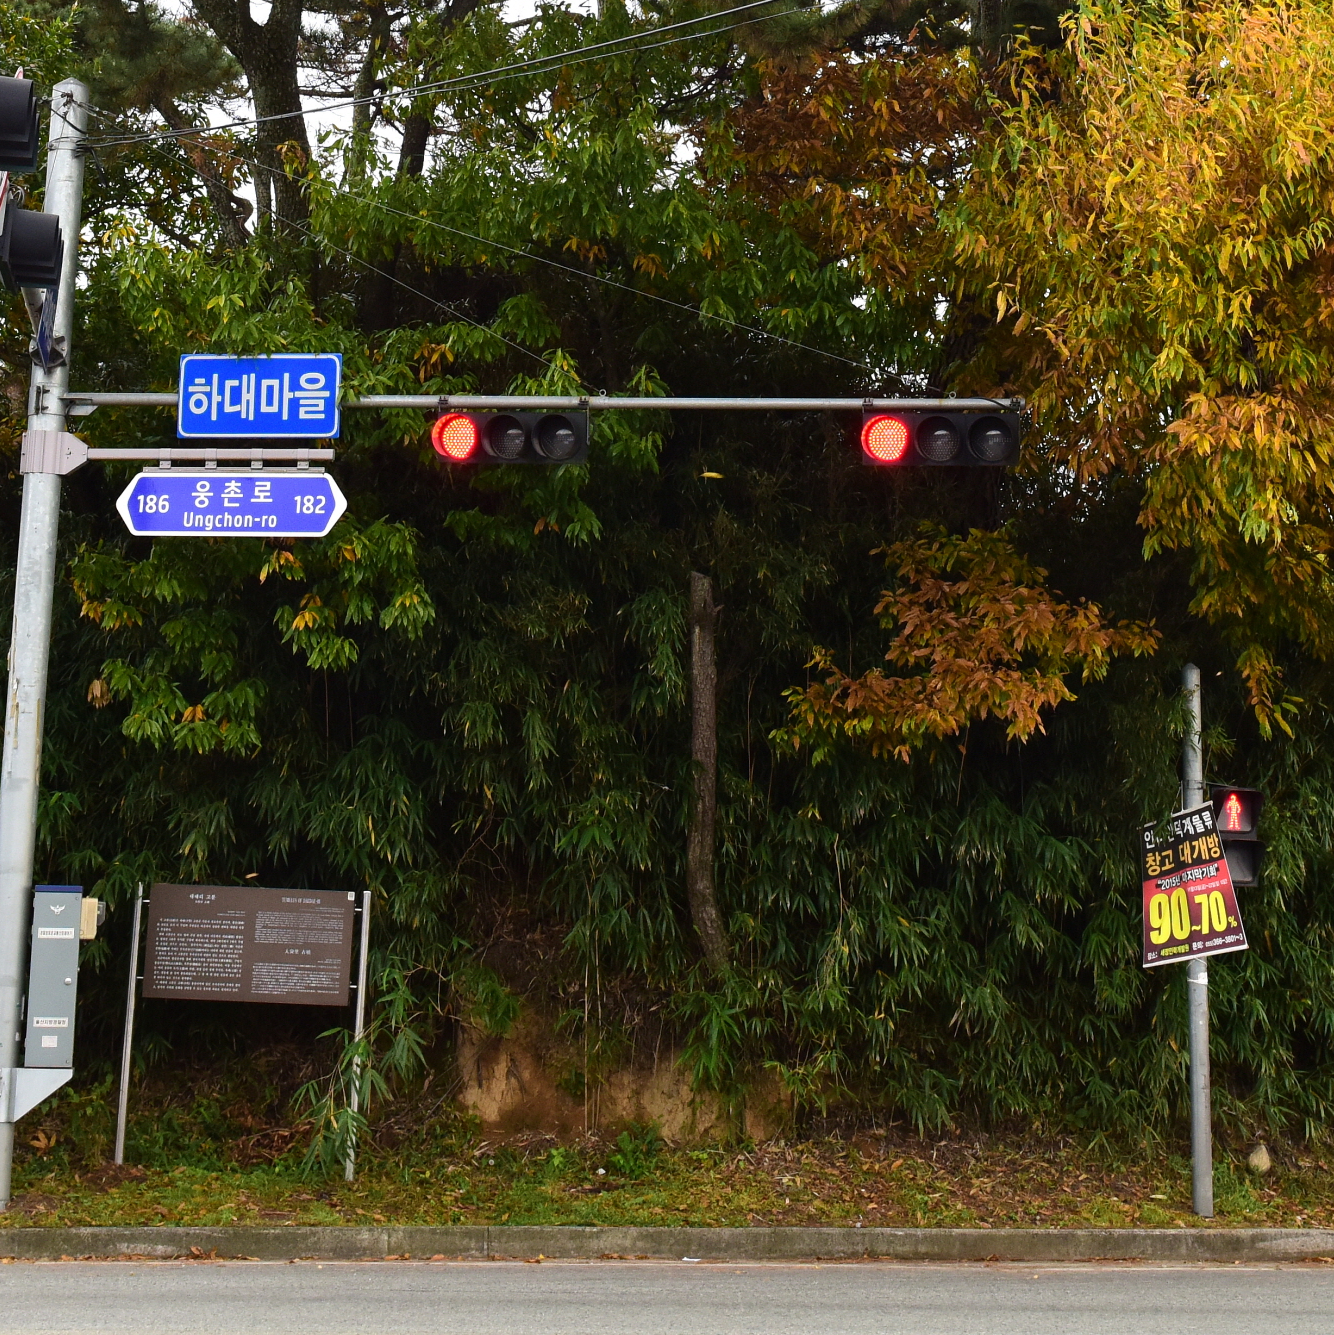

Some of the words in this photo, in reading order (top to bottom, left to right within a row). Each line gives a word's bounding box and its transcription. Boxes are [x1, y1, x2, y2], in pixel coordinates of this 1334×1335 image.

[188, 372, 330, 420] 하대마을
[137, 494, 170, 514] 186
[191, 480, 273, 508] 웅촌로
[294, 495, 326, 515] 182
[183, 512, 277, 531] Ungchon-ro
[1145, 849, 1175, 876] 창고
[1179, 833, 1221, 864] 대개방
